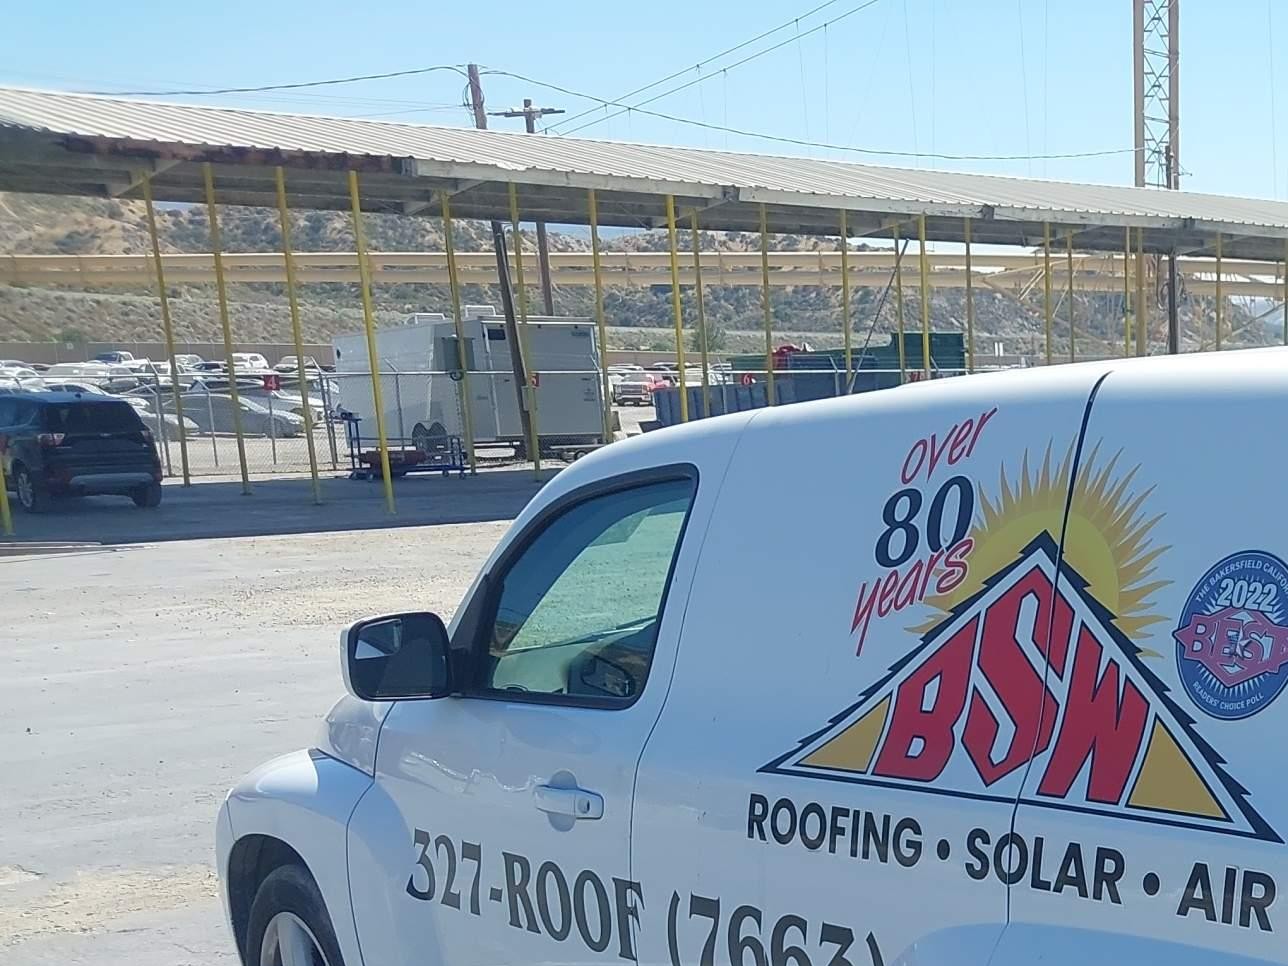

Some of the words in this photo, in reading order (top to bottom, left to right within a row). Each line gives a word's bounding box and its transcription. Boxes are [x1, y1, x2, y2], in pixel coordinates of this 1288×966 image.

[266, 375, 277, 390] 4
[901, 407, 998, 485] over
[875, 475, 975, 568] 80
[850, 537, 975, 657] years
[1195, 584, 1210, 603] THE
[1209, 559, 1263, 587] BAKERSFIELD
[1216, 578, 1278, 612] 2022
[871, 564, 1151, 806] BSW
[1192, 681, 1220, 707] READERS'
[1219, 700, 1245, 711] CHOICE
[1246, 693, 1264, 707] POLL
[406, 827, 645, 961] 327-ROOF
[747, 793, 923, 868] ROOFING
[965, 828, 1126, 904] SOLAR
[1176, 862, 1276, 932] AIR
